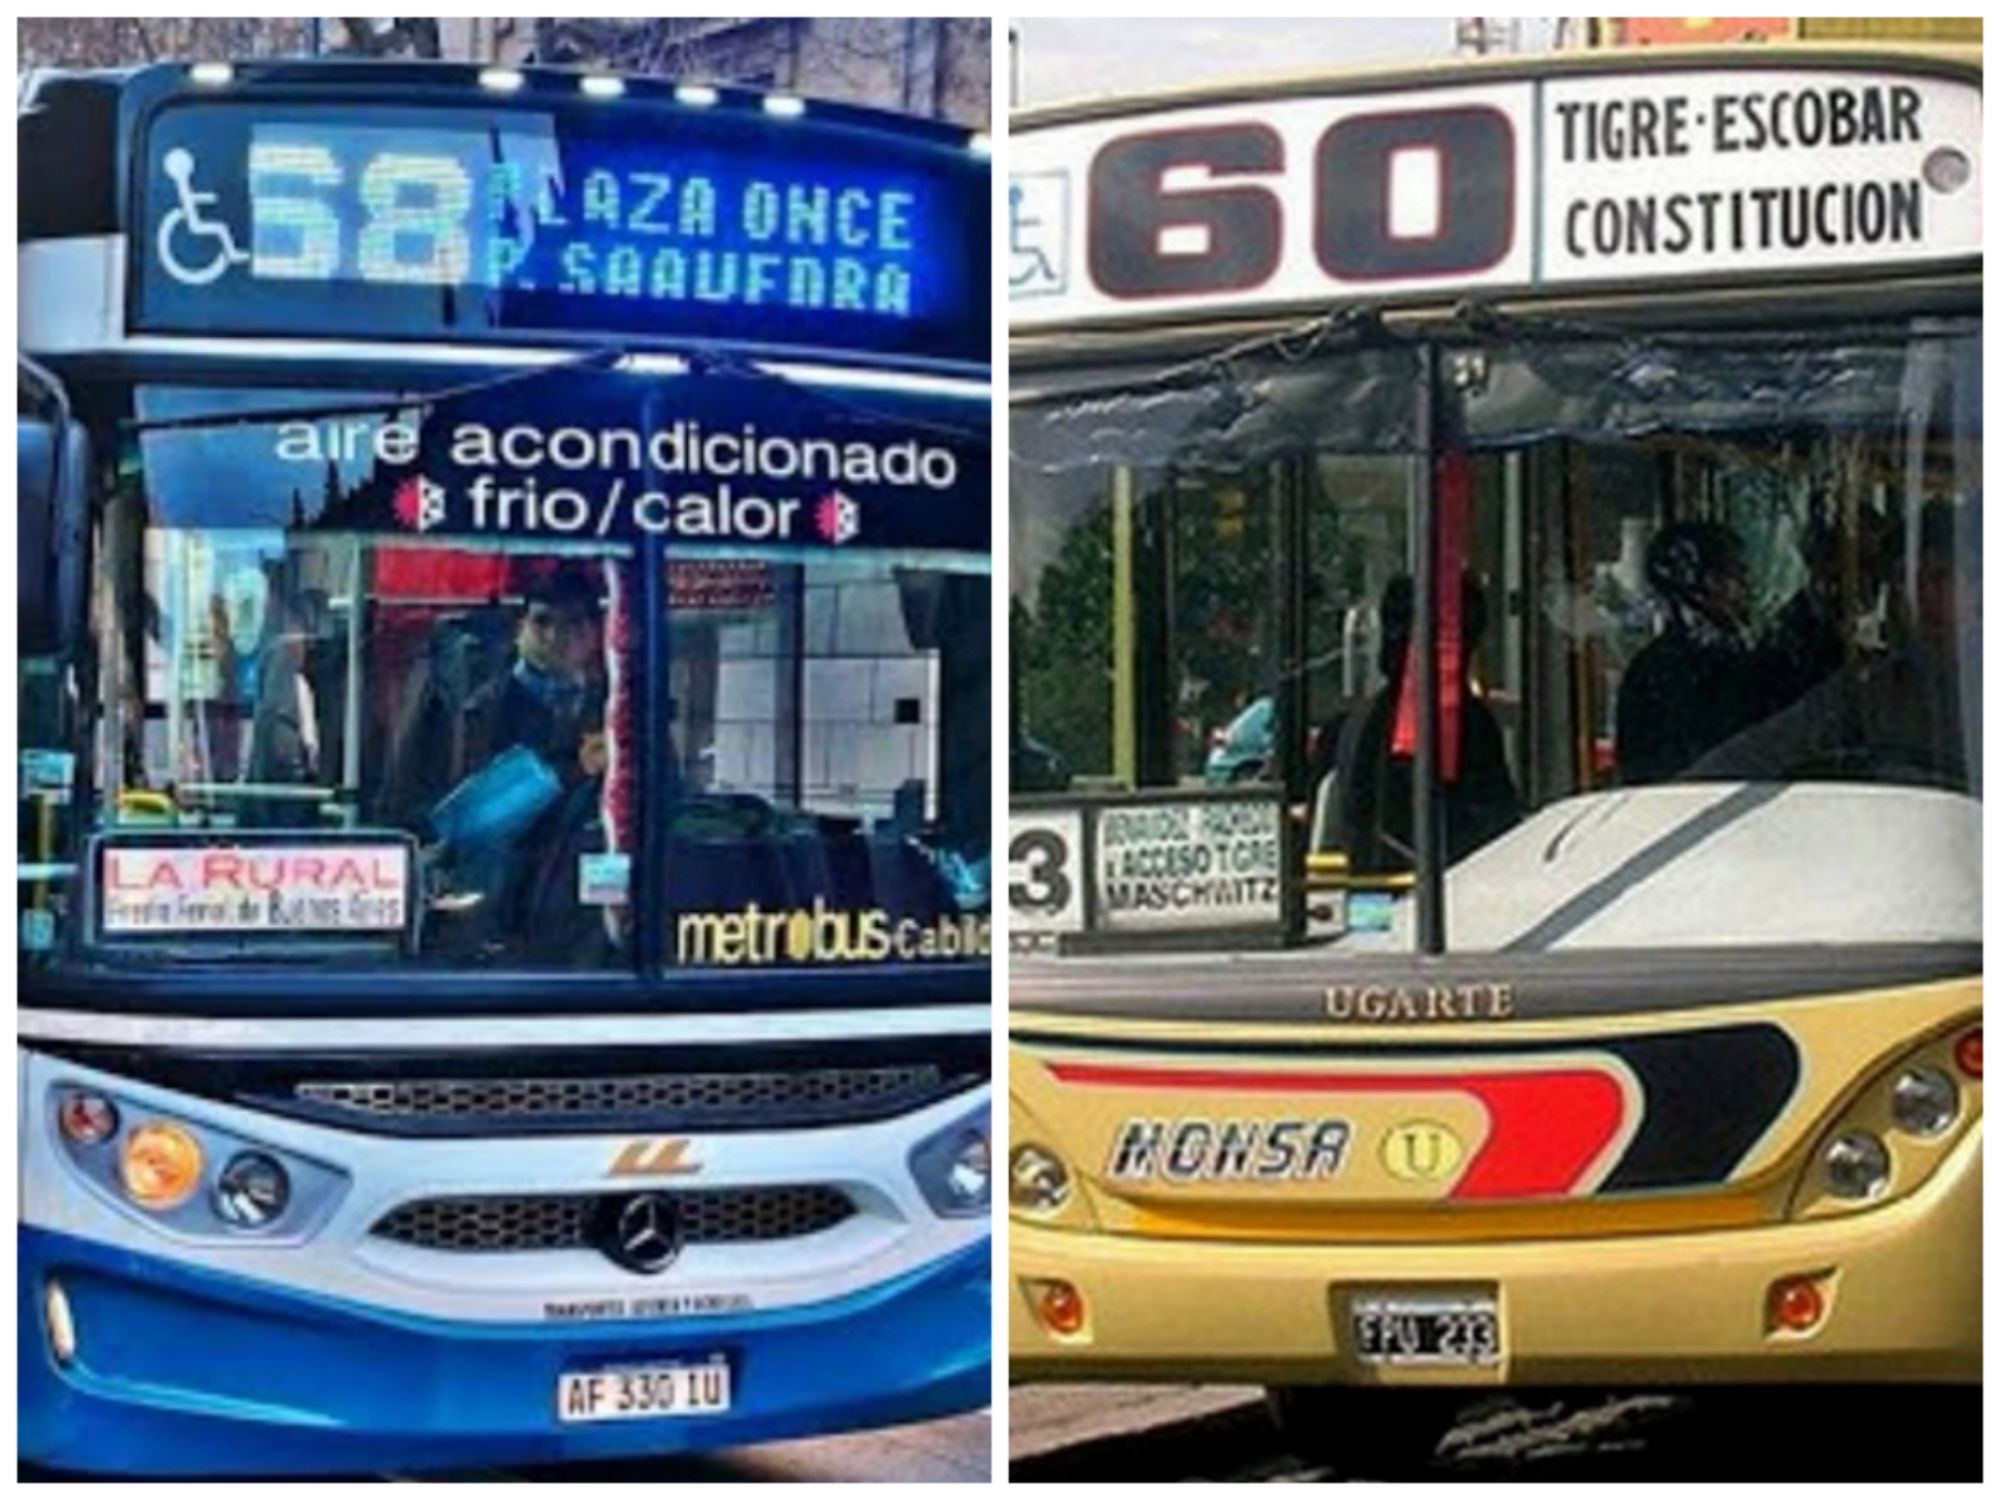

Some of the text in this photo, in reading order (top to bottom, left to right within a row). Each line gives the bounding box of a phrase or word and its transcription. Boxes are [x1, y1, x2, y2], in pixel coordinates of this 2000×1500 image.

[249, 143, 473, 284] 68
[743, 182, 914, 250] ONCE
[1087, 103, 1516, 299] 60
[1564, 180, 1922, 258] CONSTITUCION
[275, 420, 957, 489] aire acondicionado
[104, 853, 399, 890] LA RURAL
[1122, 845, 1211, 879] ACCESO
[677, 898, 889, 963] metrobus
[1325, 983, 1513, 1019] UGARTE
[567, 1379, 605, 1413] AF
[617, 1375, 675, 1410] 330
